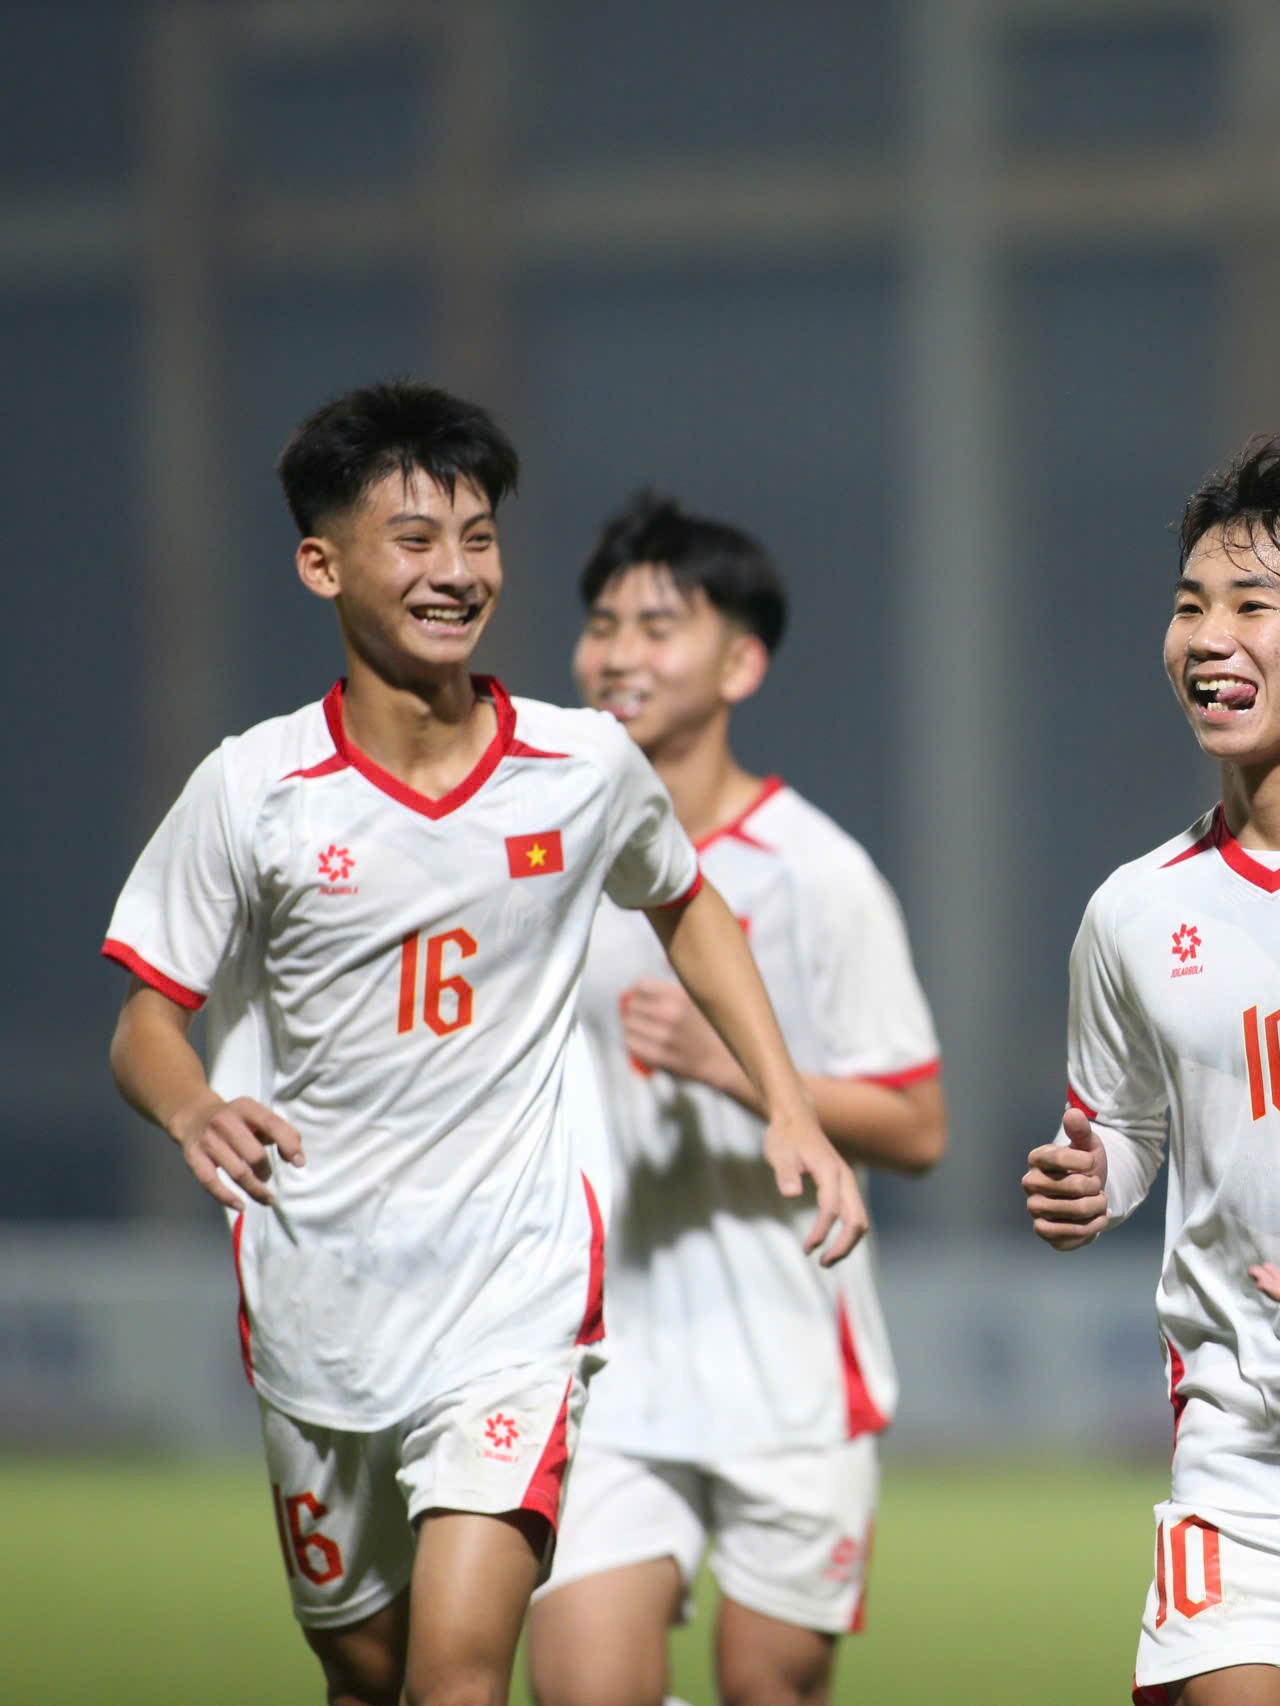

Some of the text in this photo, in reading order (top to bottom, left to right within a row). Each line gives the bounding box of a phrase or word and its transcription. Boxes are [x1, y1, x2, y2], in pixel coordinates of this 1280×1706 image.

[397, 926, 478, 1037] 16
[272, 1483, 343, 1587] 16
[1155, 1513, 1224, 1630] 10
